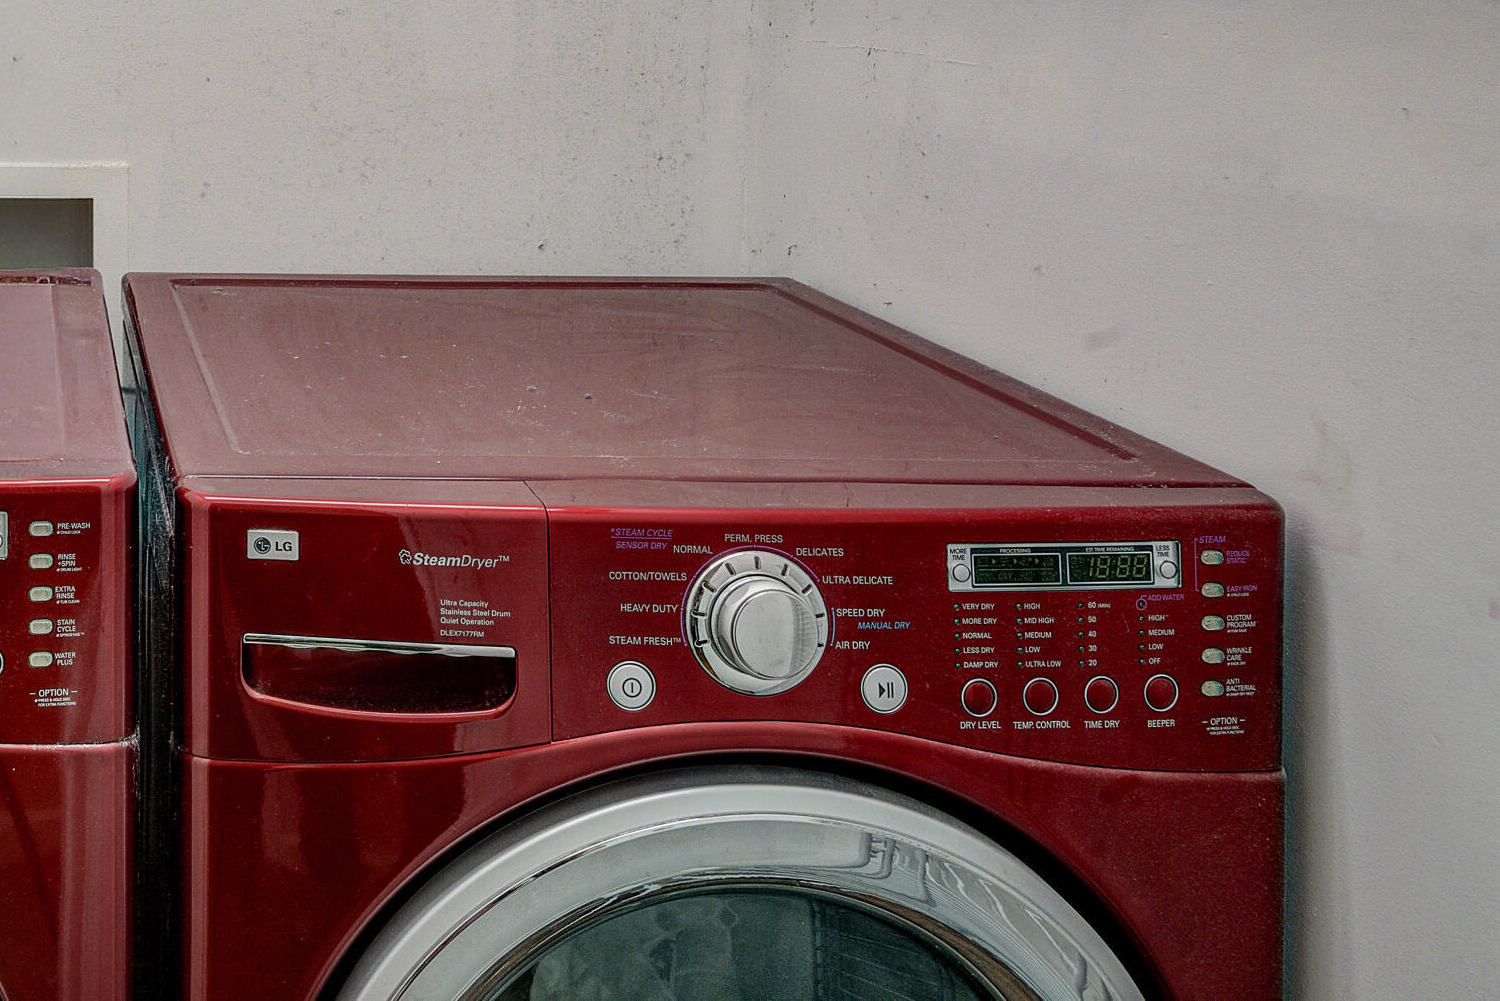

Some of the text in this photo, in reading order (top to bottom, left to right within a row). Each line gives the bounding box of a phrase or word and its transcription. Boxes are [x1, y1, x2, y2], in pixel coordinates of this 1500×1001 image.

[57, 522, 91, 530] PRE-WASH
[646, 529, 673, 537] CYCLE
[724, 533, 784, 543] PERM. PRESS
[1199, 536, 1226, 544] STEAM
[275, 541, 292, 552] LG
[616, 541, 649, 549] SENSOR
[673, 545, 713, 554] NORMAL
[795, 548, 844, 557] DELICATES
[609, 571, 688, 581] COTTON/TOWELS
[822, 576, 894, 585] ULTRA DELICATE
[55, 585, 76, 593] EXTRA
[459, 600, 489, 608] Capacity
[620, 603, 679, 613] HEAVY DUTY
[1087, 601, 1097, 609] 60
[440, 608, 511, 618] Stainless Steel Drum
[836, 608, 886, 617] SPEED DRY
[440, 617, 495, 626] Quiet Operation
[857, 621, 911, 630] MANUAL DRY
[962, 617, 997, 625] MORE DRY
[56, 625, 77, 633] CYCLE
[440, 629, 485, 638] DLEX7177RM
[1088, 630, 1097, 638] 40
[609, 635, 642, 645] STEAM
[835, 640, 871, 650] AIR DRY
[963, 646, 995, 654] LESS DRY
[54, 651, 76, 659] WATER
[57, 658, 73, 666] PLUS
[1025, 660, 1062, 668] ULTRA LOW
[1088, 659, 1098, 667] 20
[38, 688, 69, 697] OPTION
[1226, 684, 1256, 692] BACTERIAL
[960, 720, 1002, 730] DRY LEVEL
[1013, 720, 1071, 730] TEMP. CONTROL
[1084, 719, 1120, 729] TIME DRY
[1147, 718, 1176, 728] BEEPER
[1210, 717, 1238, 726] OPTION
